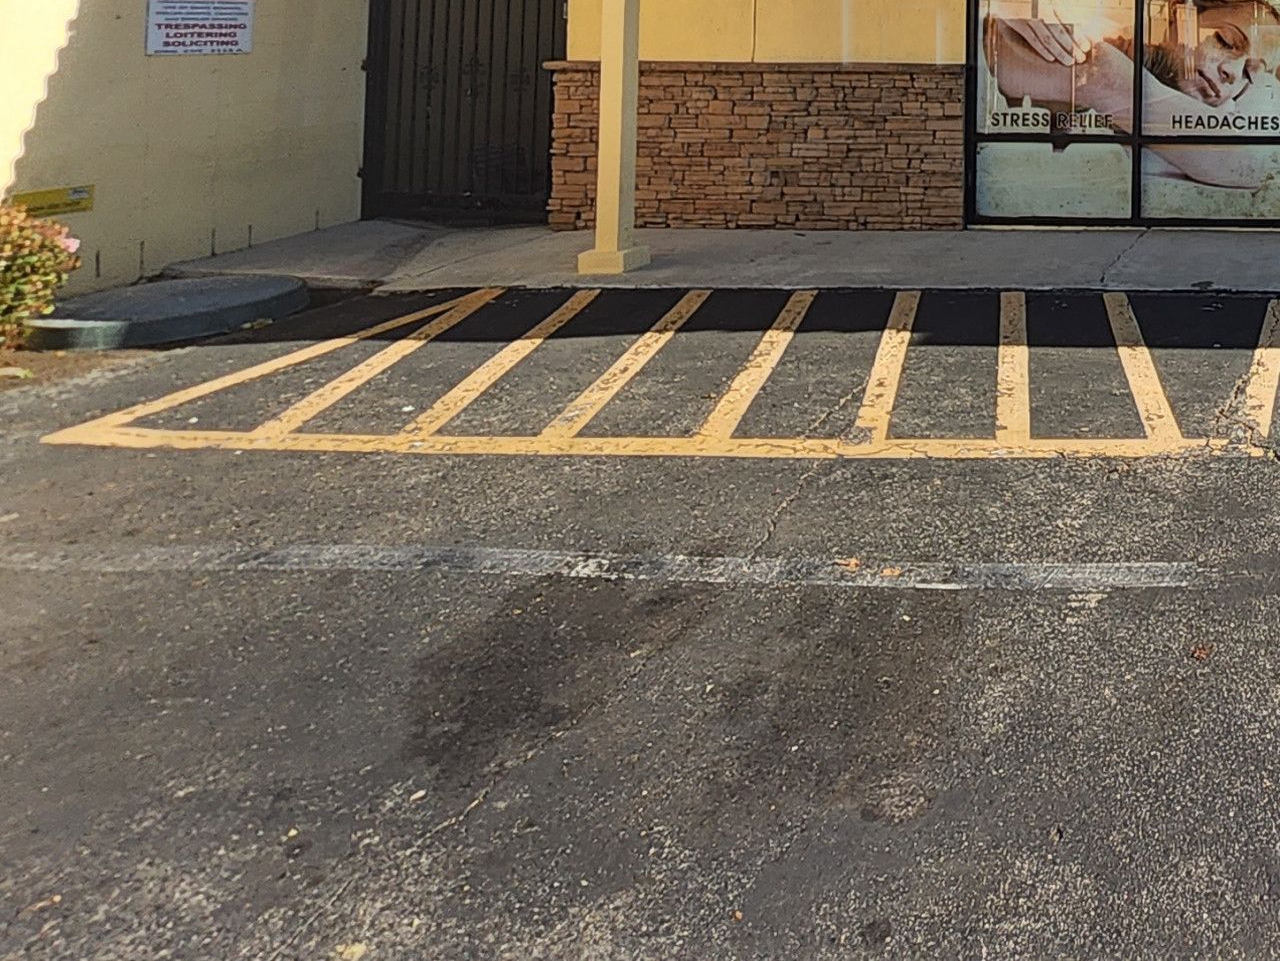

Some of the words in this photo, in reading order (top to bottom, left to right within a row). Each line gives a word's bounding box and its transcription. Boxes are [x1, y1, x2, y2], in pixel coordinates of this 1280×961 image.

[155, 22, 247, 30] TRESPASSING
[990, 112, 1050, 127] STRESS
[1056, 113, 1113, 128] RELIEF
[1171, 115, 1280, 131] HEADACHES
